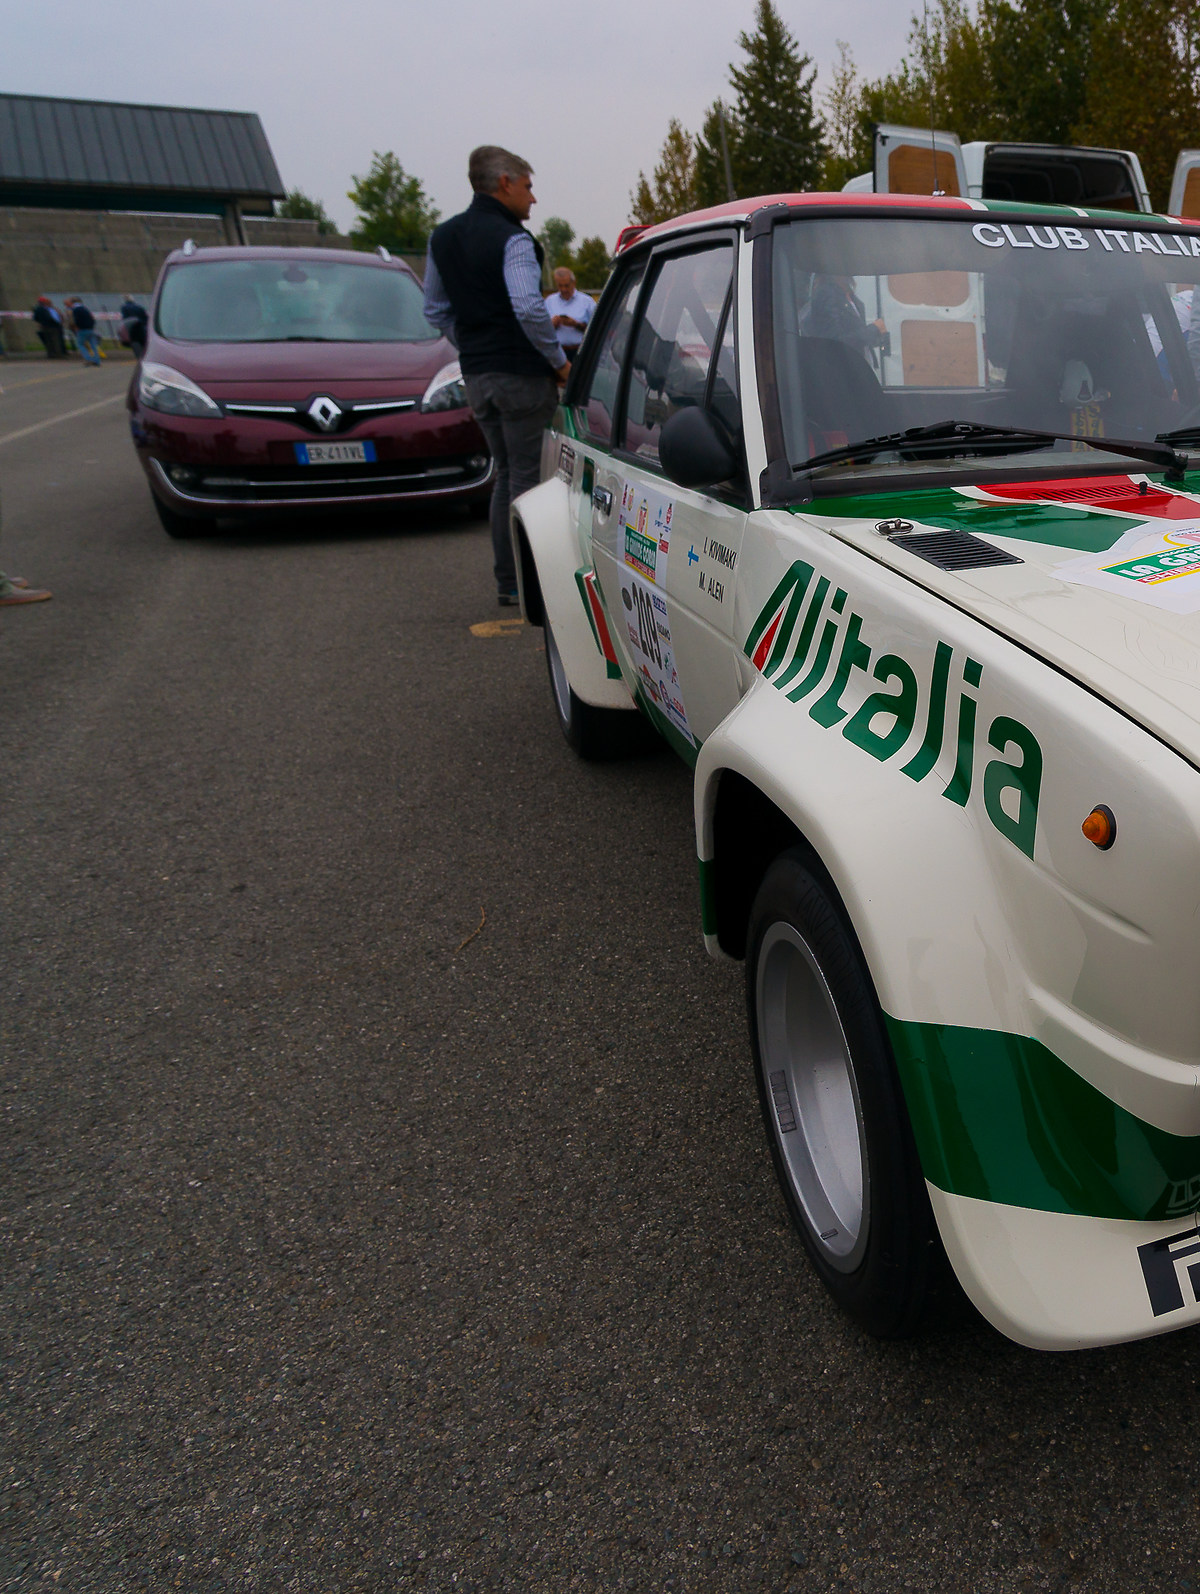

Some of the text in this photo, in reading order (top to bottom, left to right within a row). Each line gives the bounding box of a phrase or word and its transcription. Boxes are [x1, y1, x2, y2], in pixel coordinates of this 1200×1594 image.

[971, 223, 1090, 250] CLUB
[1118, 564, 1163, 577] LA
[707, 577, 725, 604] ALEN
[743, 559, 1043, 862] Alitalia
